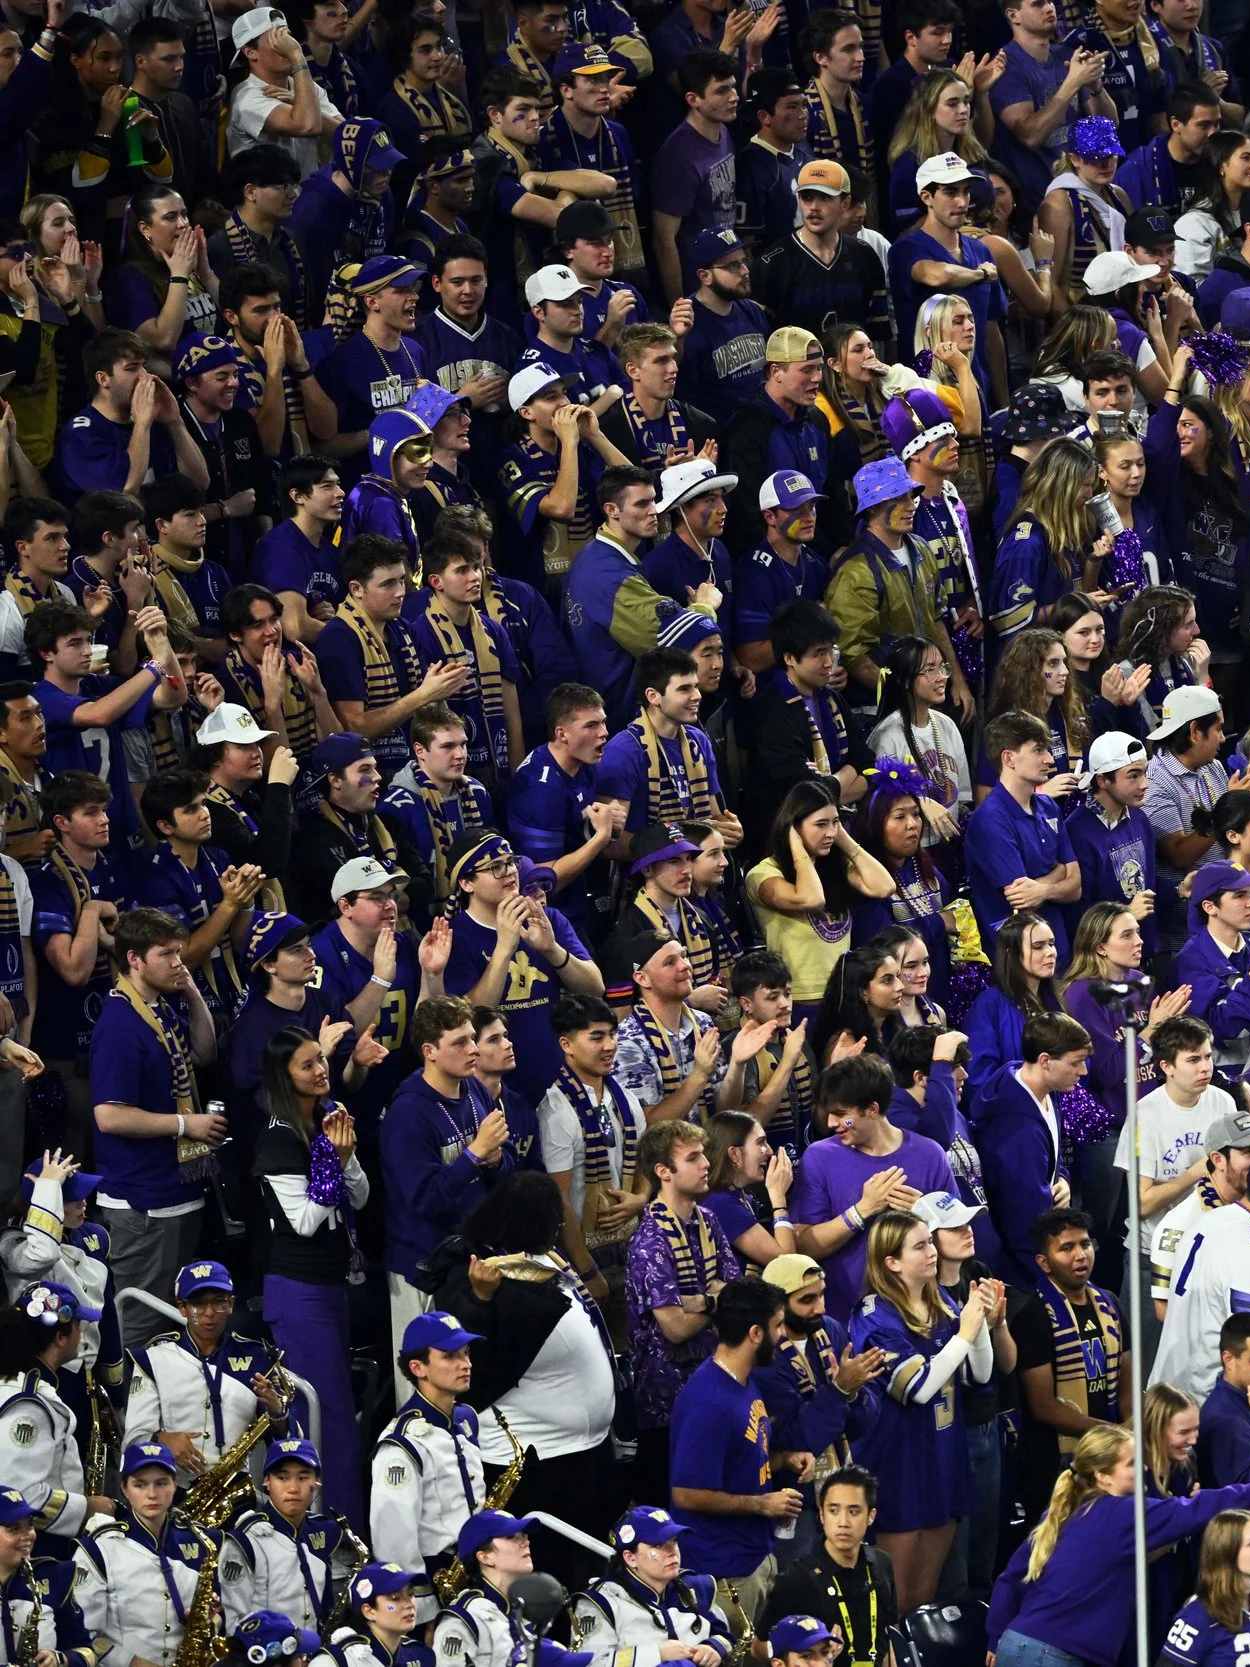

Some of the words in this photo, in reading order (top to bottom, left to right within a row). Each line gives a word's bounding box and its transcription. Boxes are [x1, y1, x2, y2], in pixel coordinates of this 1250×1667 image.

[177, 336, 231, 373] TAC
[711, 332, 766, 379] WASHINGT
[1014, 521, 1033, 541] 3
[546, 560, 570, 572] YOFF
[752, 549, 774, 568] 19
[205, 611, 221, 621] PLA
[467, 752, 489, 763] YOFF
[538, 765, 551, 784] 1
[383, 788, 416, 808] 17
[518, 974, 526, 989] 9
[1162, 1132, 1205, 1165] EARL
[1162, 1167, 1179, 1177] ON
[82, 1233, 101, 1253] W
[189, 1264, 214, 1280] W
[1173, 1232, 1205, 1297] 1
[439, 1315, 462, 1331] W
[228, 1355, 254, 1372] W
[1080, 1337, 1107, 1380] W
[140, 1444, 163, 1456] W
[280, 1440, 302, 1453] W
[3, 1490, 24, 1503] W
[308, 1530, 326, 1550] W
[178, 1542, 200, 1560] W
[1167, 1618, 1199, 1652] 25
